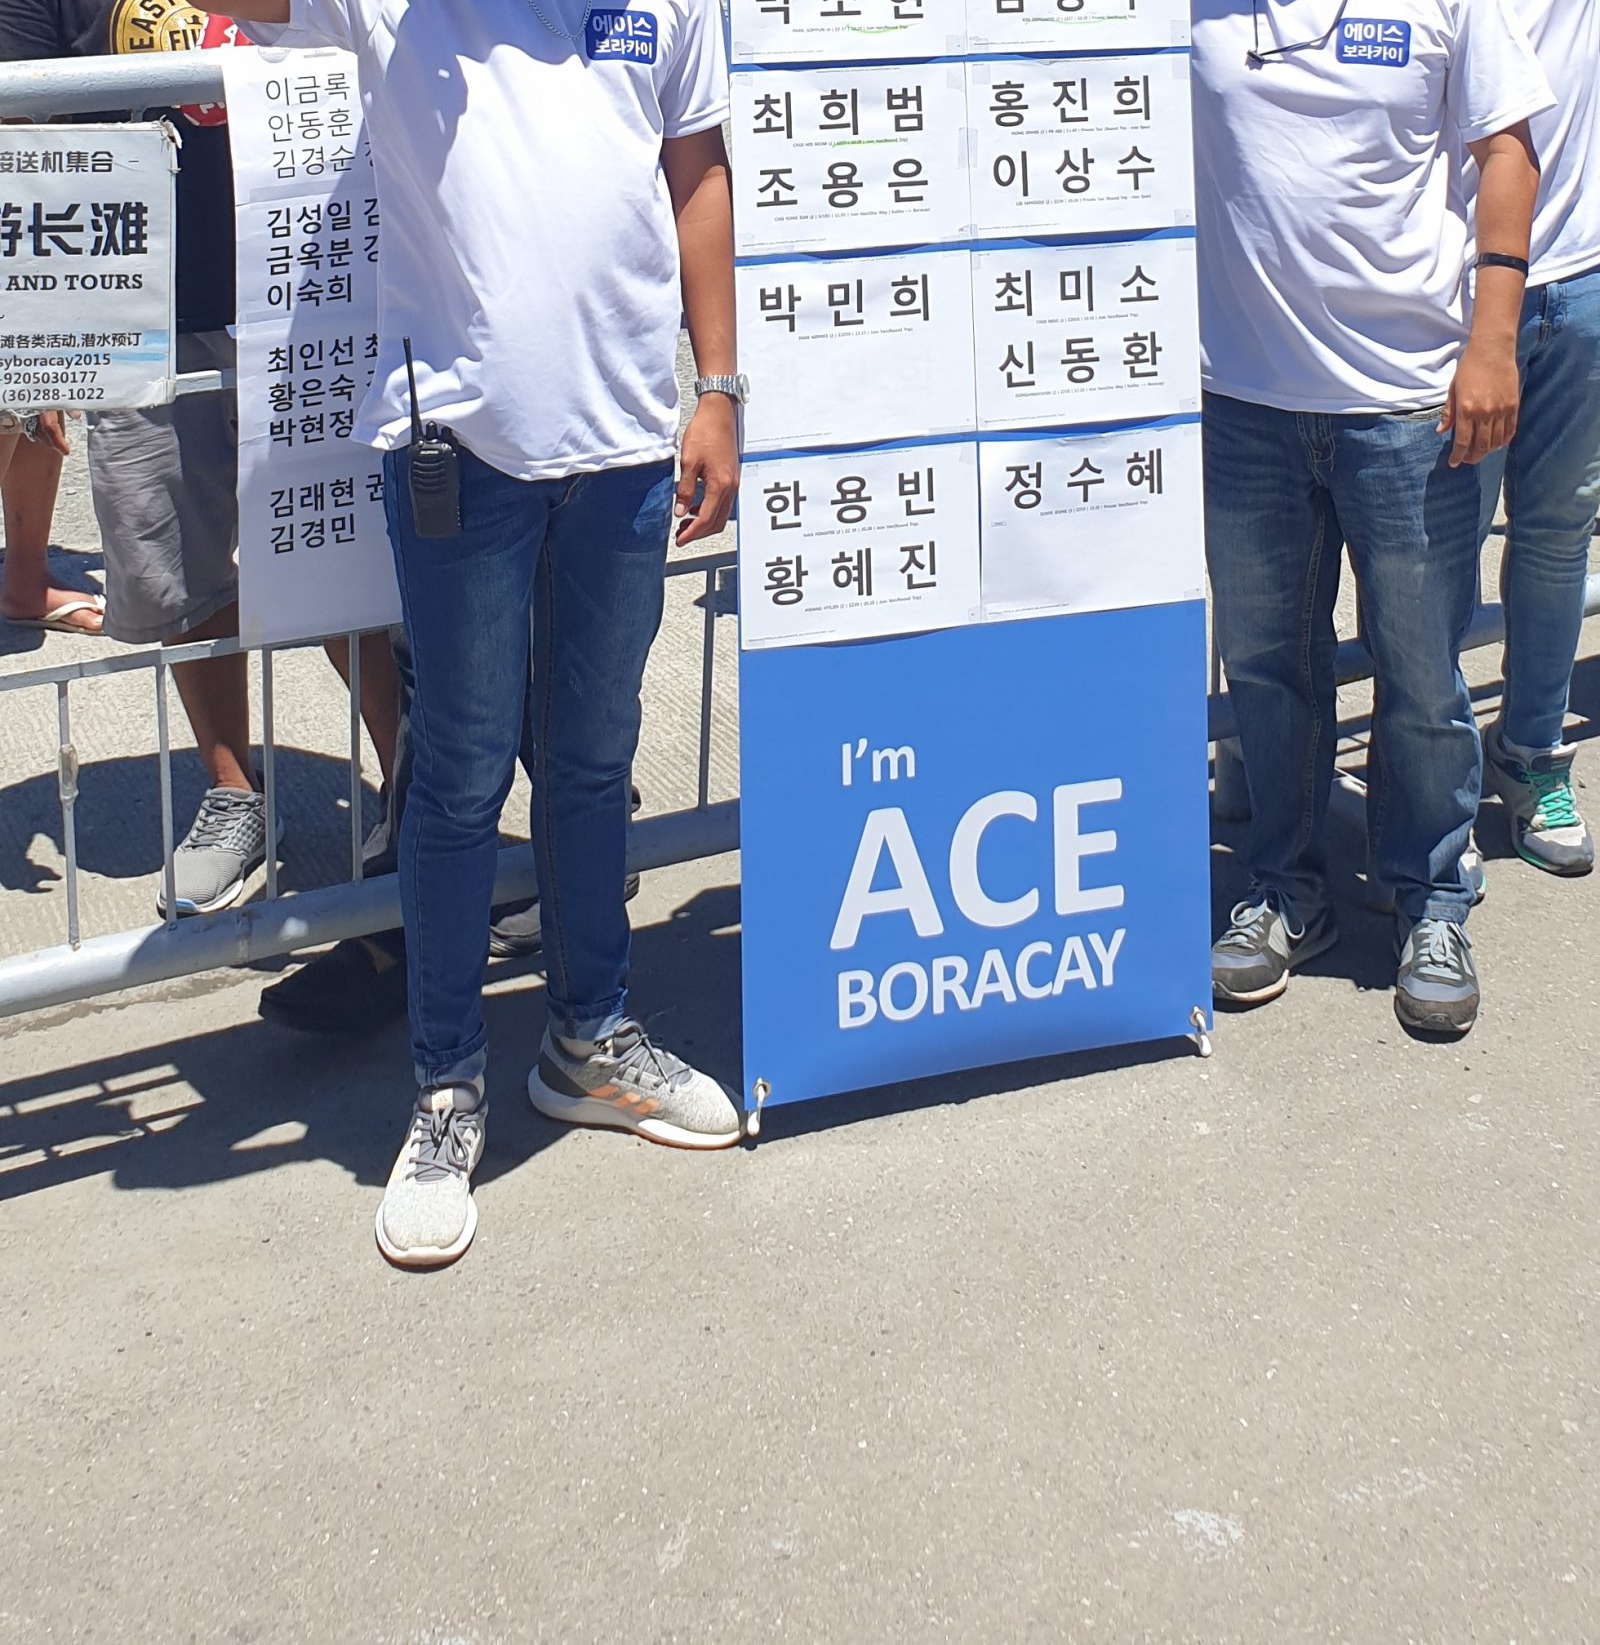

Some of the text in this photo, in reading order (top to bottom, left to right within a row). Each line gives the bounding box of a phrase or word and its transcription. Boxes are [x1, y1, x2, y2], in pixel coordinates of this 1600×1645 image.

[592, 14, 653, 37] 에이스
[1344, 23, 1404, 44] 에이스
[595, 38, 652, 59] 보라카이
[1342, 44, 1403, 62] 보라카이
[265, 72, 350, 106] 이금록
[268, 108, 353, 143] 안동훈
[273, 145, 355, 179] 김경순
[267, 200, 352, 238] 김성일
[266, 238, 353, 276] 금옥분
[5, 274, 143, 291] AND TOURS
[267, 274, 352, 311] 이숙희
[267, 335, 354, 374] 최인선
[2, 388, 104, 404] (36)288-1022
[268, 373, 355, 412] 황은숙
[270, 409, 354, 447] 박현정
[270, 477, 355, 518] 김래현
[270, 513, 356, 554] 김경민
[830, 777, 1125, 949] ACE
[838, 928, 1127, 1029] BORACAY
